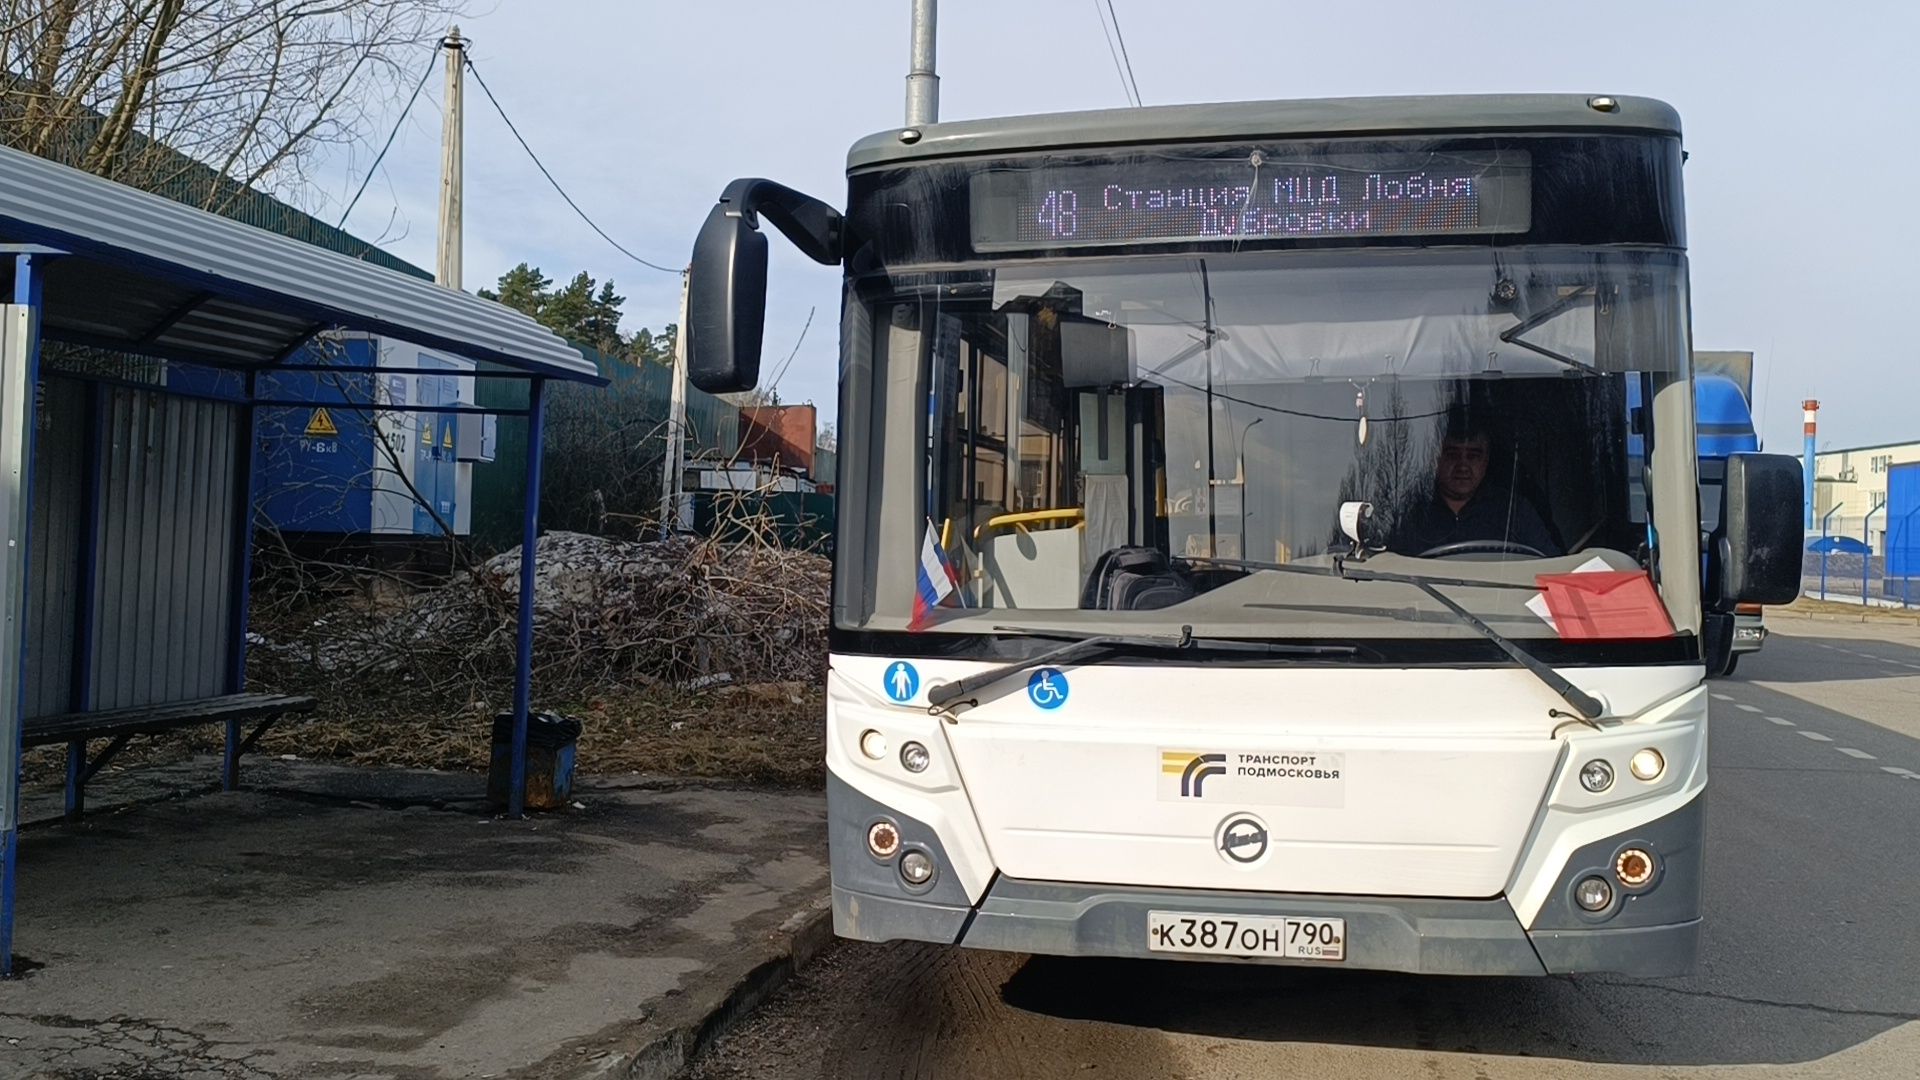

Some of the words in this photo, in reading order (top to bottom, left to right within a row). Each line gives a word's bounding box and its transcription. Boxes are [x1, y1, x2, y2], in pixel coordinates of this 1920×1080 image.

[1104, 184, 1250, 210] Станция
[1274, 176, 1340, 206] МЦД
[1362, 172, 1471, 200] Лобня
[1038, 190, 1077, 237] 48
[1238, 754, 1317, 766] ТРАНСПОРТ
[1237, 766, 1340, 780] ПОДМОСКОВЬЯ
[1287, 921, 1335, 945] 790
[1298, 945, 1321, 956] RUS
